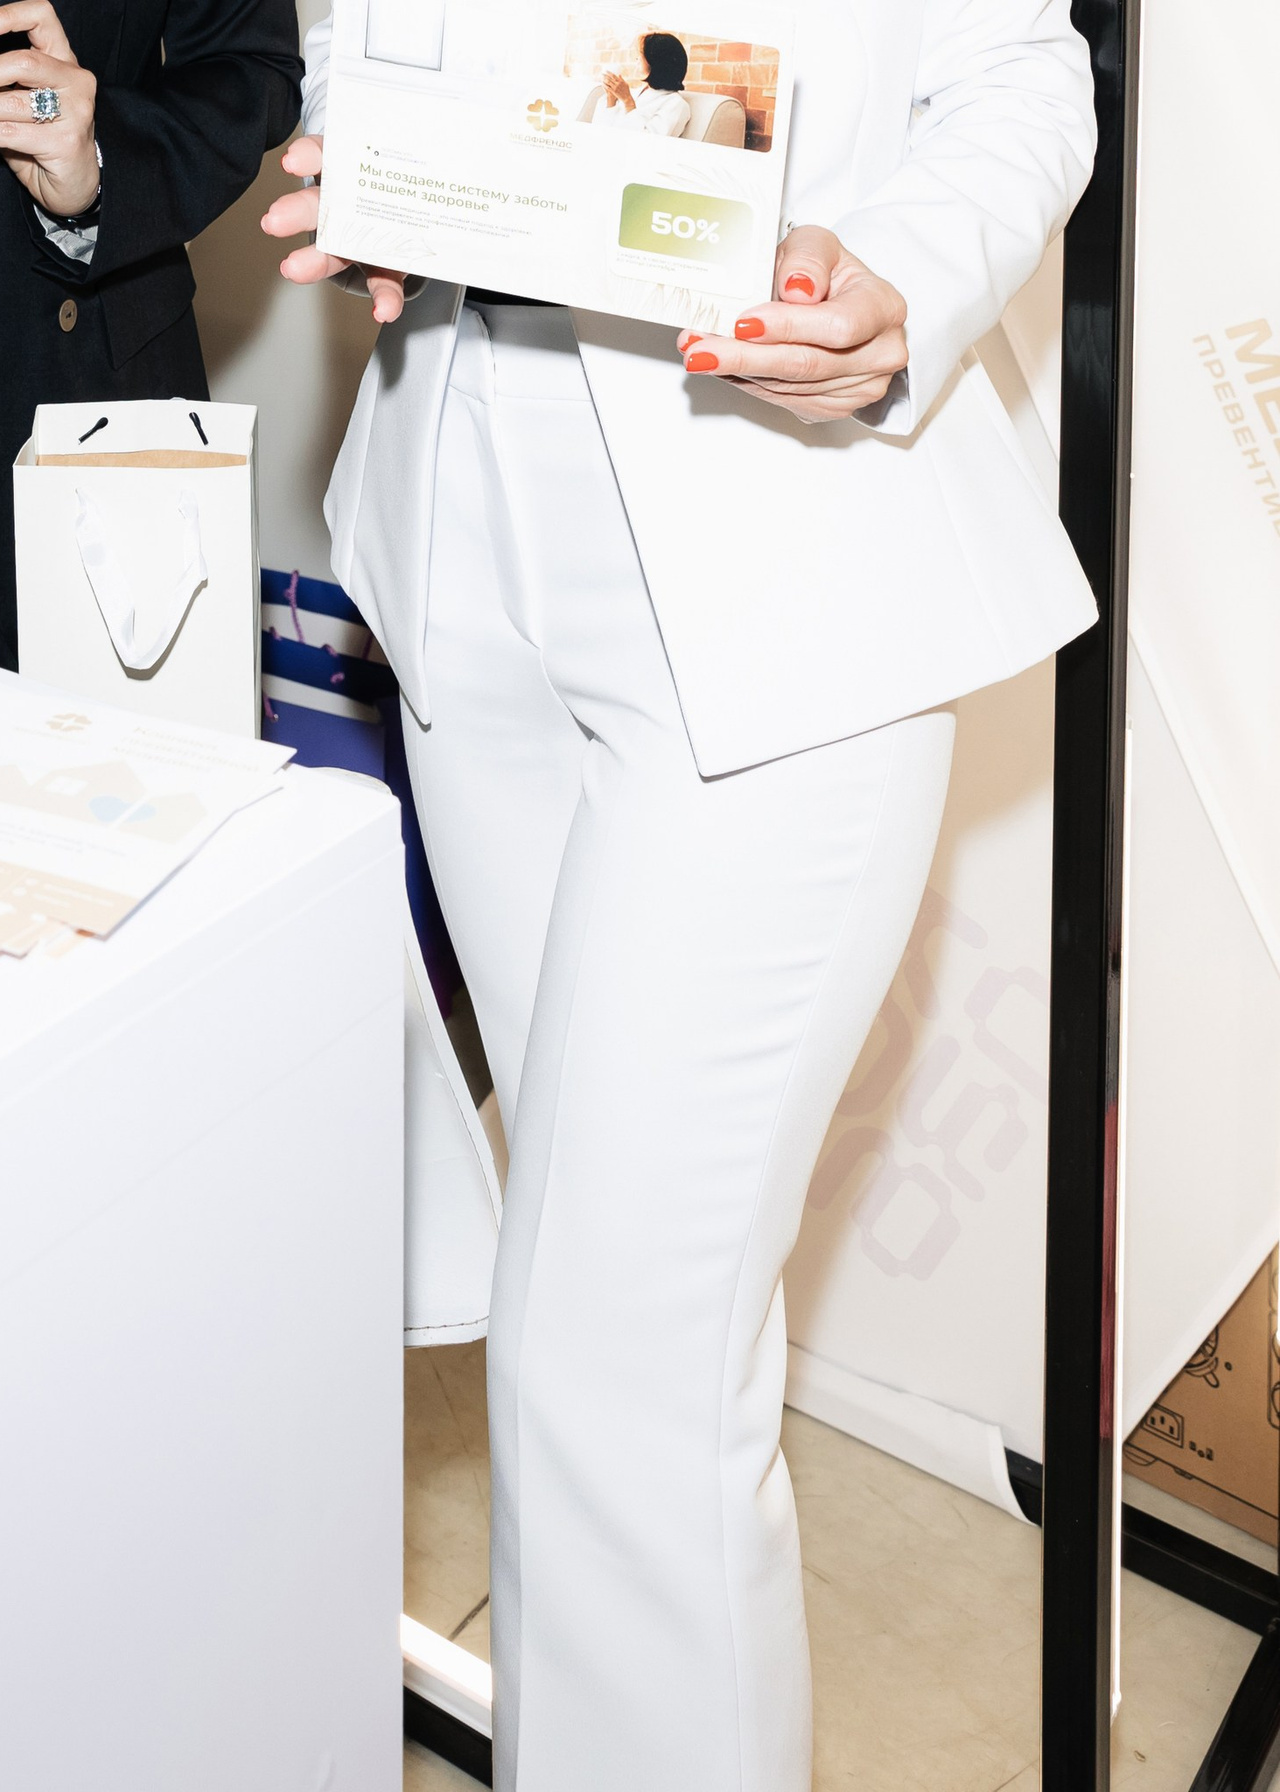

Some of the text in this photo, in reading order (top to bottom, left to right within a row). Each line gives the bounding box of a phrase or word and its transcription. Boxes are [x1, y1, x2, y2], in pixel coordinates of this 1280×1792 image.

[358, 178, 490, 213] о вашем здоровье
[359, 162, 568, 212] Мы создаем систему заботы
[651, 210, 720, 244] 50%
[1193, 333, 1280, 538] ПРЕВЕНТИ
